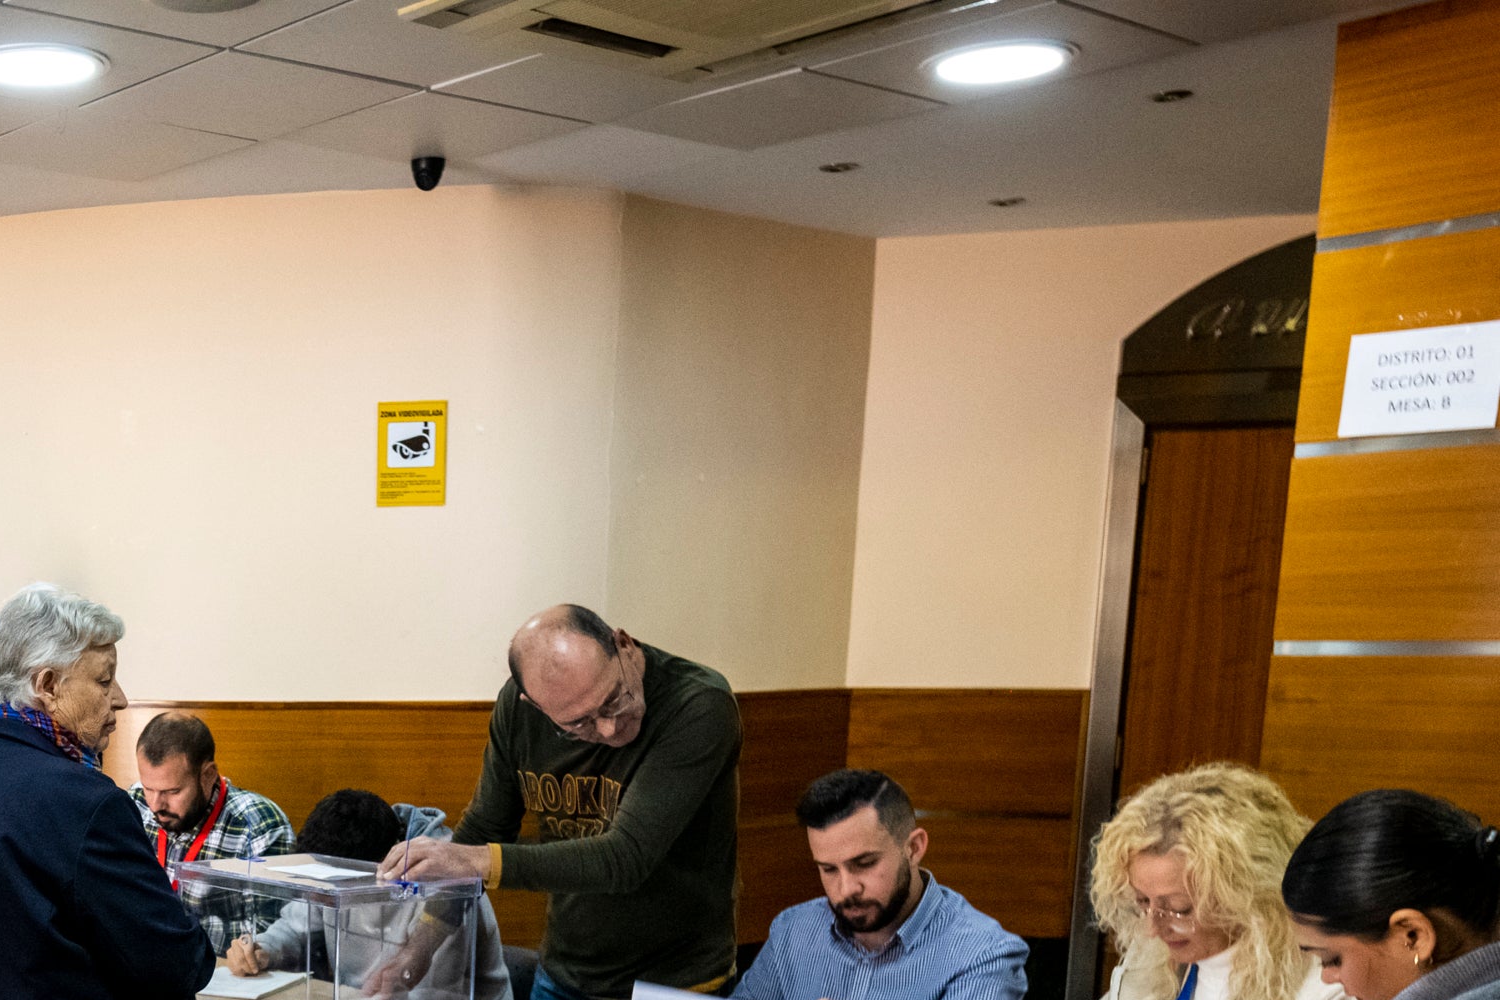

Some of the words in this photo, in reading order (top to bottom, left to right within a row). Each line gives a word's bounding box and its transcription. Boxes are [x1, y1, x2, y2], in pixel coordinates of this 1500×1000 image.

[1378, 347, 1451, 367] DISTRITO:
[1456, 345, 1474, 360] 01
[1371, 371, 1442, 391] SECCIÓN:
[1446, 369, 1475, 385] 002
[380, 410, 396, 418] ZONA
[1388, 398, 1436, 413] MESA:
[1441, 395, 1451, 409] B
